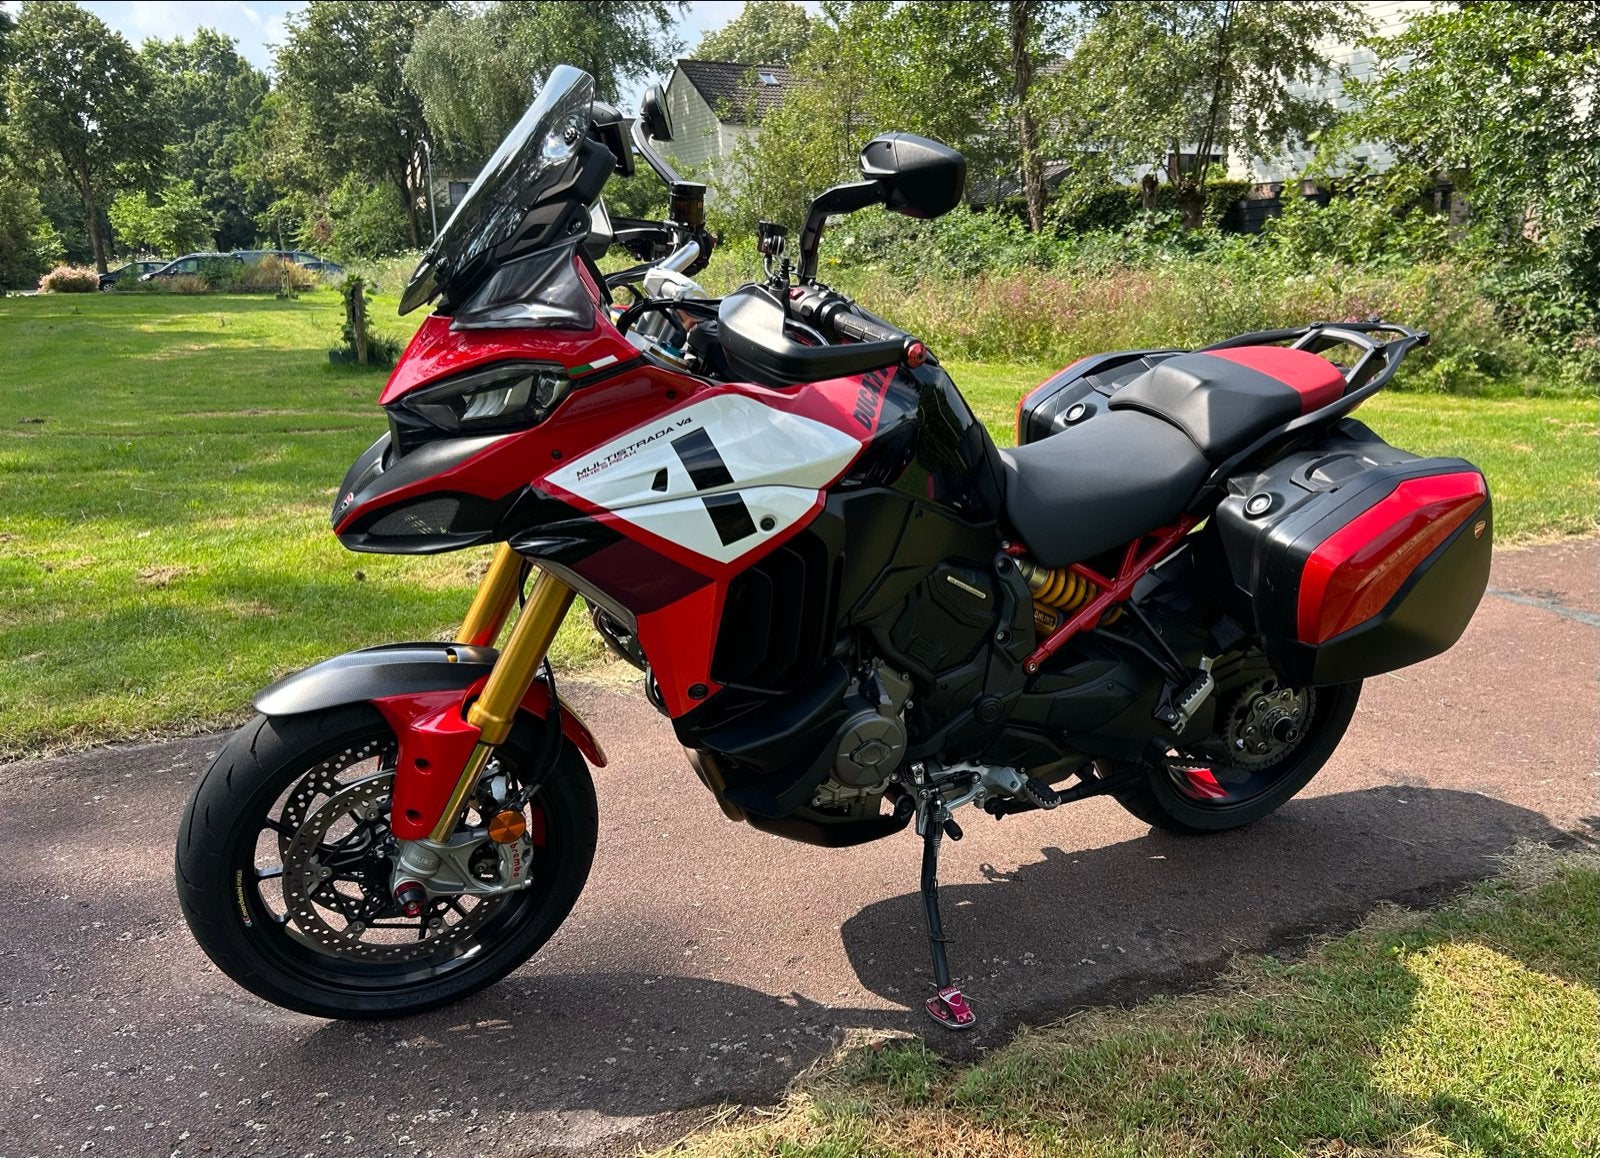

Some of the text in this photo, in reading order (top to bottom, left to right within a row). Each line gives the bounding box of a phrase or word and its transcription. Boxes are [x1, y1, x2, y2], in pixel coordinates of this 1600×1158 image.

[576, 417, 693, 477] MULTISTRADA V4
[509, 842, 522, 877] brembo
